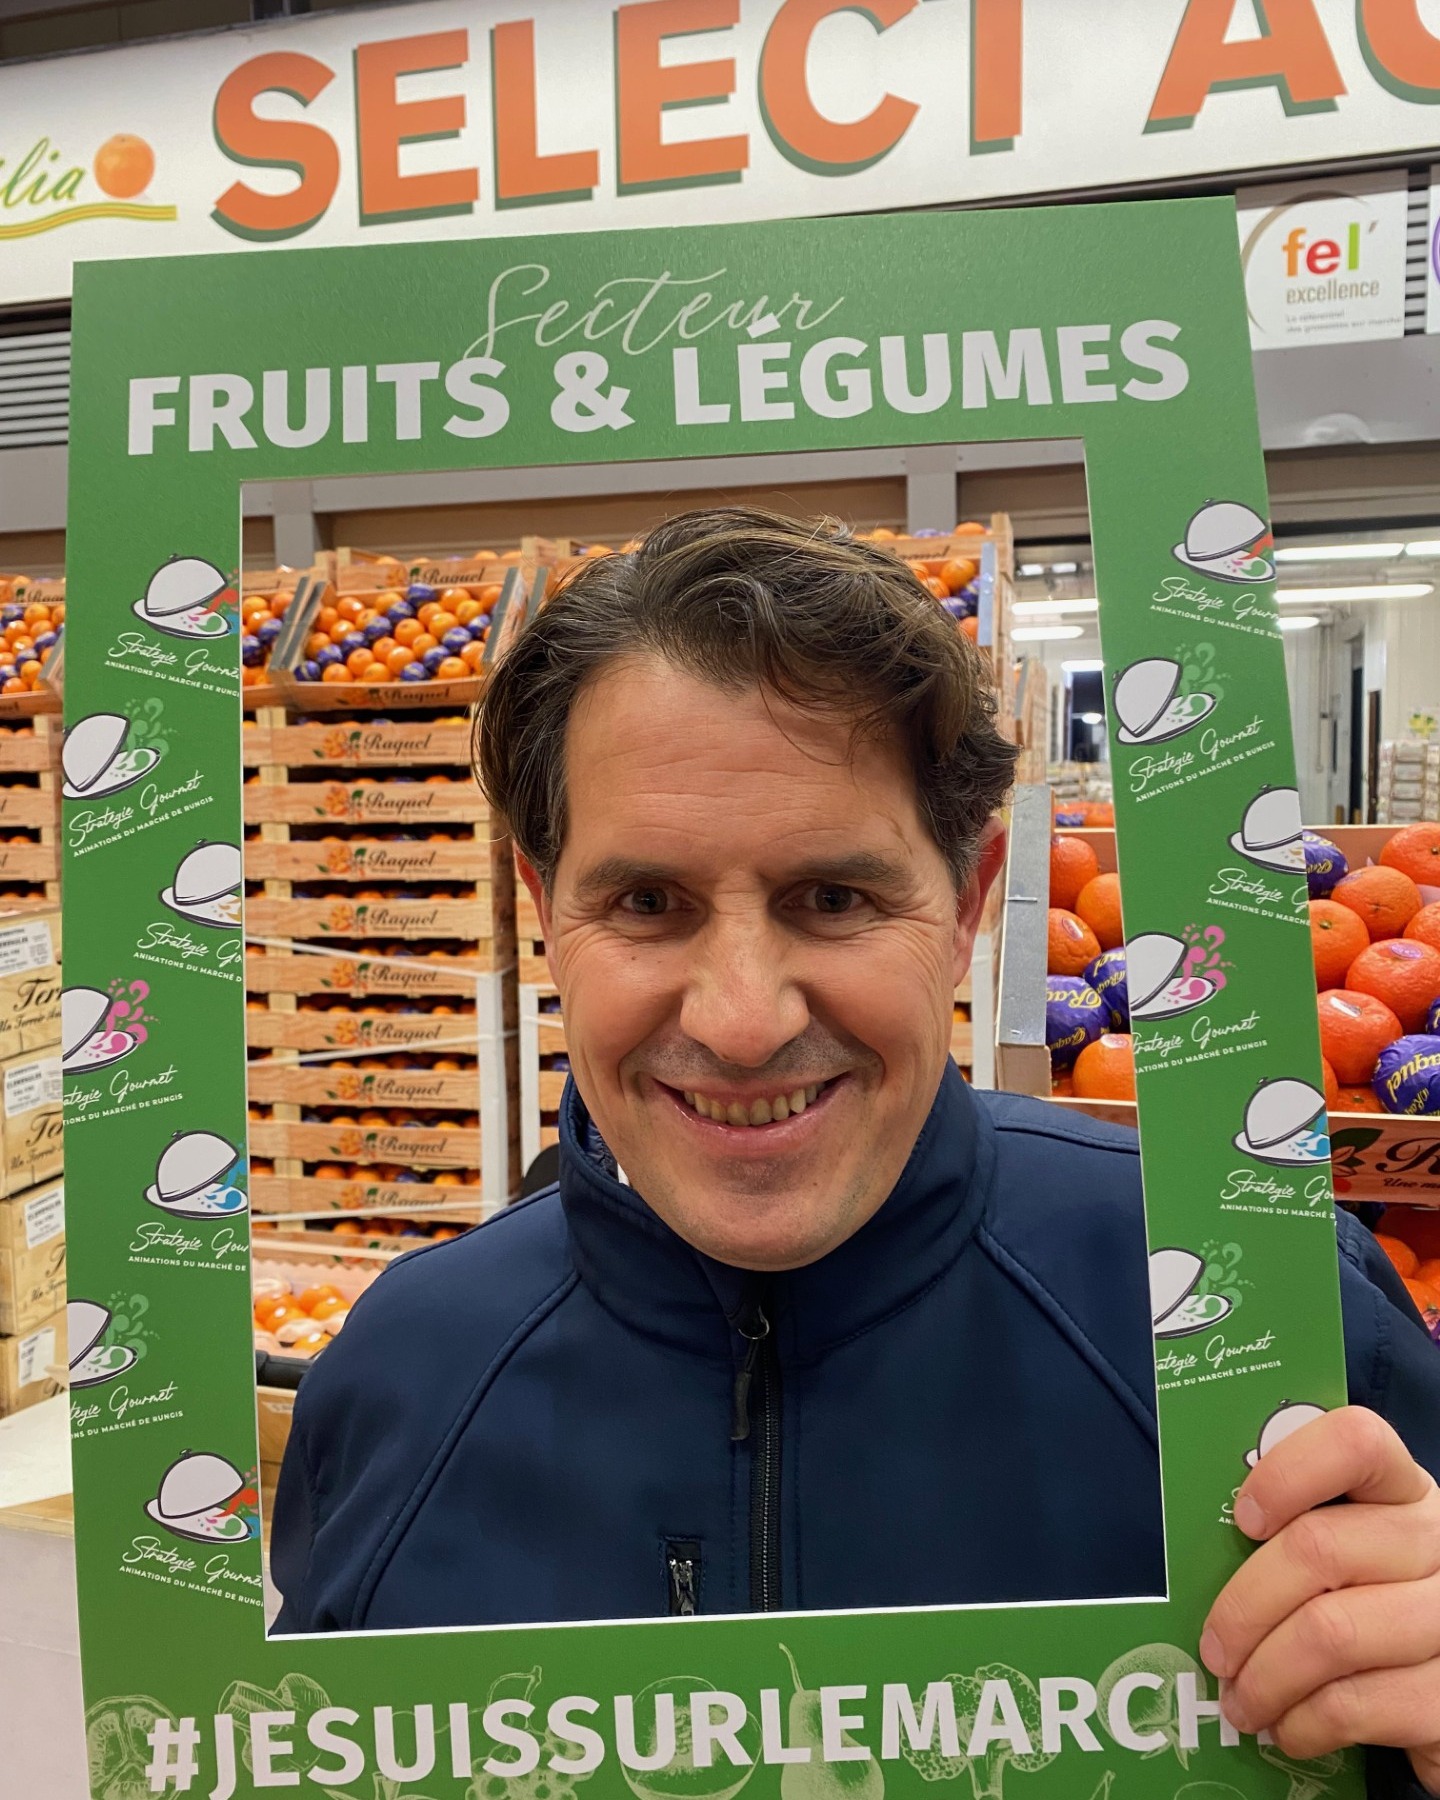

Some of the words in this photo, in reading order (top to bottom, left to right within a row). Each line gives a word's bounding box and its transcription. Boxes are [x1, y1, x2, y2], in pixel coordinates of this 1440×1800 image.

[0, 137, 85, 208] lia
[1286, 279, 1380, 304] excellence
[463, 264, 844, 362] Secteur
[128, 357, 511, 455] FRUITS
[550, 351, 636, 433] &
[673, 312, 1190, 426] LÉGUMES
[1151, 605, 1202, 621] ANIMATIONS
[1203, 616, 1216, 625] DU
[1217, 619, 1252, 634] MARCHÉ
[1253, 628, 1265, 637] DE
[104, 660, 154, 680] ANIMATIONS
[155, 671, 167, 681] DU
[169, 674, 201, 689] MARCHÉ
[203, 683, 215, 692] DE
[364, 731, 432, 757] Raquel
[1200, 715, 1264, 762] Gourmet
[1135, 778, 1185, 804] ANIMATIONS
[1185, 771, 1199, 783] DU
[1199, 758, 1233, 777] MARCHÉ
[1233, 753, 1245, 763] DE
[1246, 740, 1276, 758] RUNGIS
[140, 769, 204, 816] Gourmet
[366, 791, 435, 816] Raquel
[73, 833, 122, 858] ANIMATIONS
[124, 827, 136, 838] DU
[137, 813, 171, 832] MARCHÉ
[171, 807, 184, 818] DE
[184, 795, 214, 813] RUNGIS
[369, 851, 436, 874] Raquel
[371, 909, 439, 933] Raquel
[1206, 897, 1260, 915] ANIMATIONS
[1261, 909, 1275, 918] DU
[133, 952, 184, 969] ANIMATIONS
[186, 963, 199, 972] DU
[200, 966, 235, 981] MARCHÉ
[374, 1021, 442, 1045] Raquel
[1191, 1011, 1261, 1050] Gourmet
[1171, 1057, 1184, 1066] DU
[1185, 1048, 1221, 1064] MARCHÉ
[1223, 1046, 1235, 1055] DE
[1236, 1039, 1268, 1053] RUNGIS
[109, 1064, 178, 1104] Gourmet
[377, 1077, 445, 1101] Raquel
[88, 1111, 100, 1120] DU
[102, 1102, 138, 1117] MARCHÉ
[139, 1100, 151, 1109] DE
[152, 1092, 184, 1107] RUNGIS
[380, 1136, 448, 1158] Raquel
[1384, 1177, 1418, 1188] Une
[1220, 1203, 1274, 1214] ANIMATIONS
[1276, 1206, 1289, 1216] DU
[1291, 1206, 1327, 1219] MARCHÉ
[128, 1255, 181, 1267] ANIMATIONS
[183, 1258, 196, 1268] DU
[197, 1260, 233, 1271] MARCHÉ
[234, 1263, 247, 1272] DE
[1205, 1330, 1276, 1369] Gourmet
[1184, 1376, 1197, 1386] DU
[1198, 1368, 1234, 1383] MARCHÉ
[1236, 1365, 1249, 1375] DE
[1250, 1359, 1282, 1373] RUNGIS
[108, 1381, 179, 1420] Gourmet
[87, 1426, 100, 1436] DU
[101, 1417, 137, 1434] MARCHÉ
[138, 1415, 151, 1426] DE
[152, 1409, 184, 1423] RUNGIS
[119, 1565, 172, 1585] ANIMATIONS
[173, 1578, 186, 1588] DU
[187, 1582, 223, 1598] MARCHÉ
[224, 1591, 236, 1601] DE
[146, 1670, 1275, 1800] #JESUISSURLEMARCH
